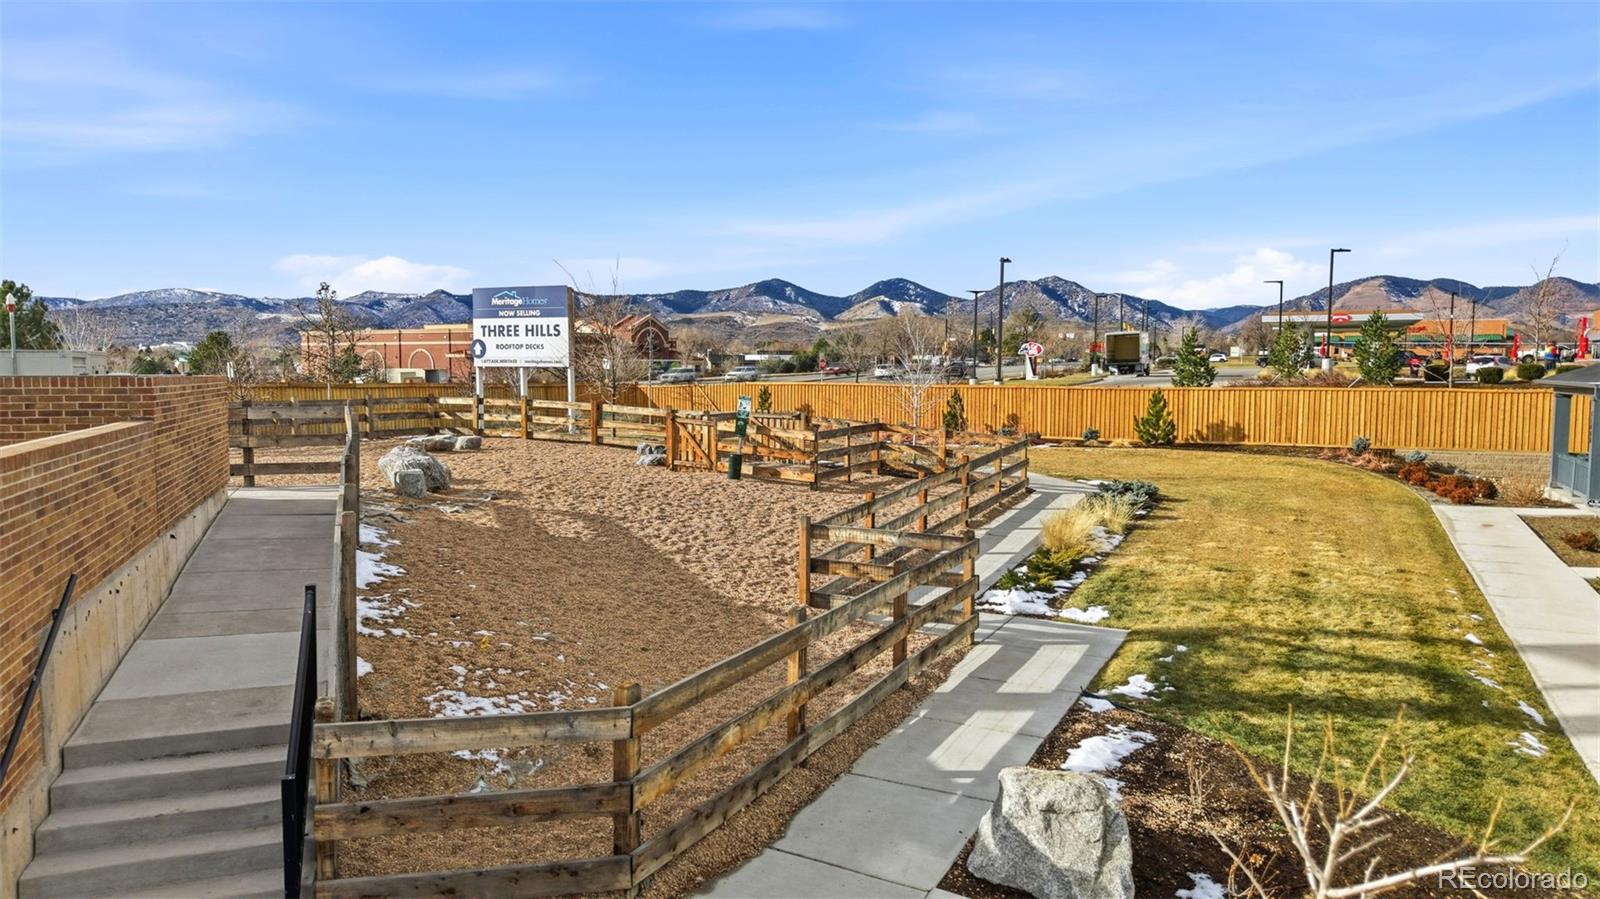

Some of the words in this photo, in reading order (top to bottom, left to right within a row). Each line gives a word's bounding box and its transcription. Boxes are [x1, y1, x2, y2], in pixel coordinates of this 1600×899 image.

[516, 309, 541, 317] SELLING
[481, 324, 520, 338] THREE
[525, 324, 561, 337] HILLS
